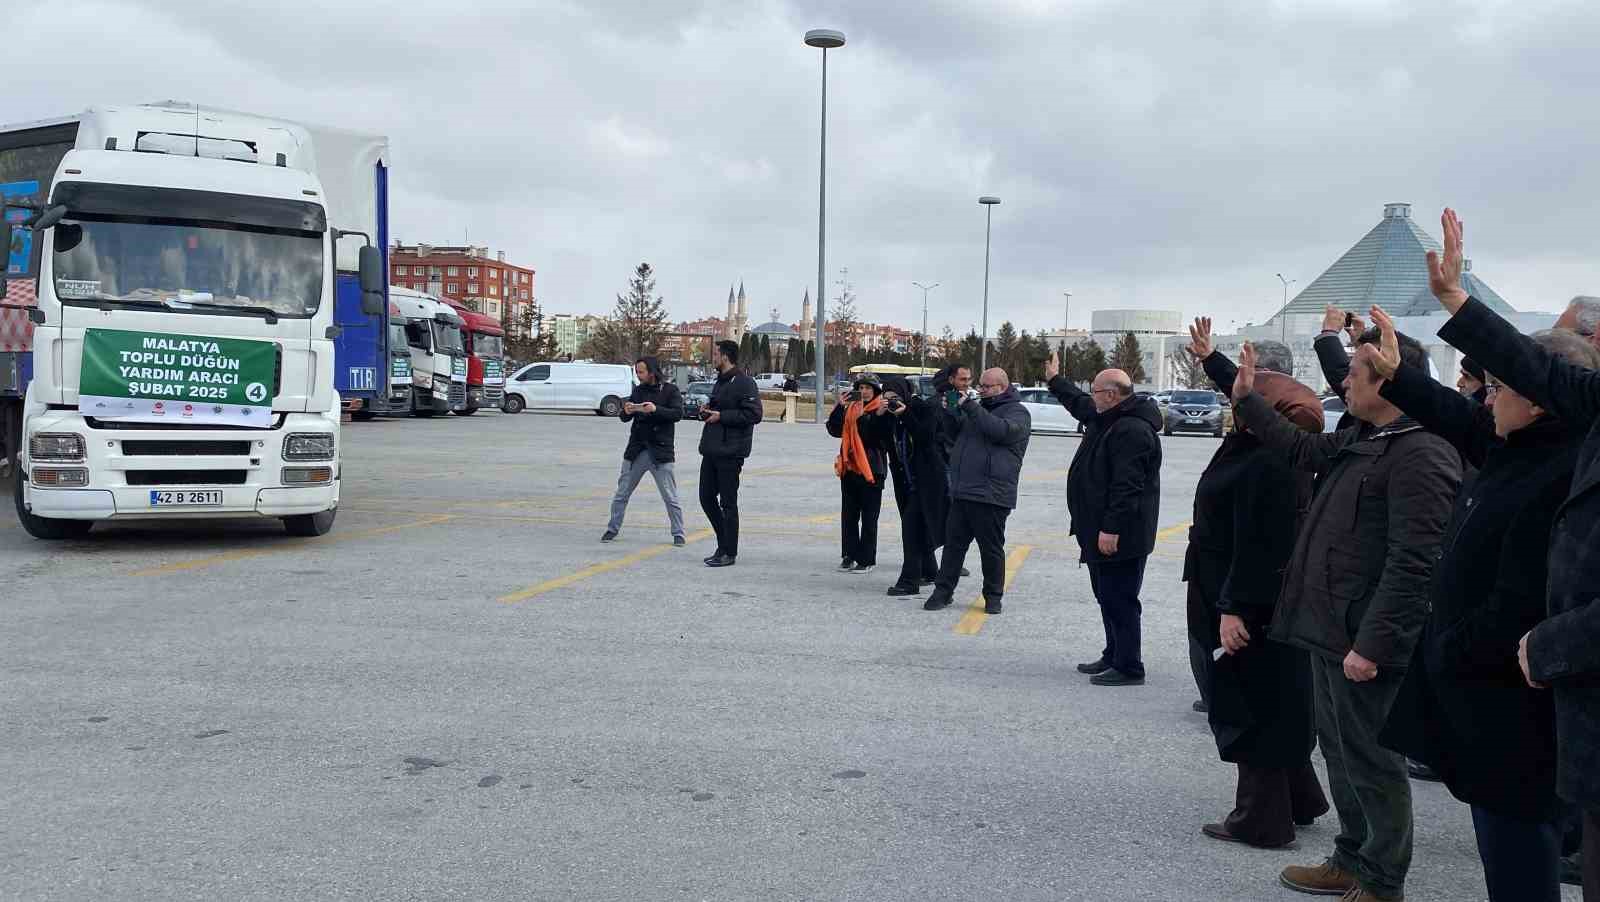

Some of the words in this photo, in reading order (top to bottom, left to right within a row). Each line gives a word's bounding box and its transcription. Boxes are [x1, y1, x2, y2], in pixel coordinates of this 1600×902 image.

[143, 337, 220, 353] MALATYA
[120, 350, 175, 366] TOPLU
[181, 353, 240, 370] DÜĞÜN
[120, 366, 184, 381] YARDIM
[188, 371, 238, 385] ARACI
[352, 369, 374, 389] TIR
[128, 381, 184, 396] ŞUBAT
[189, 385, 227, 399] 2025
[249, 385, 263, 400] 4
[157, 492, 172, 504] 42
[177, 492, 184, 504] B
[190, 492, 218, 504] 2611
